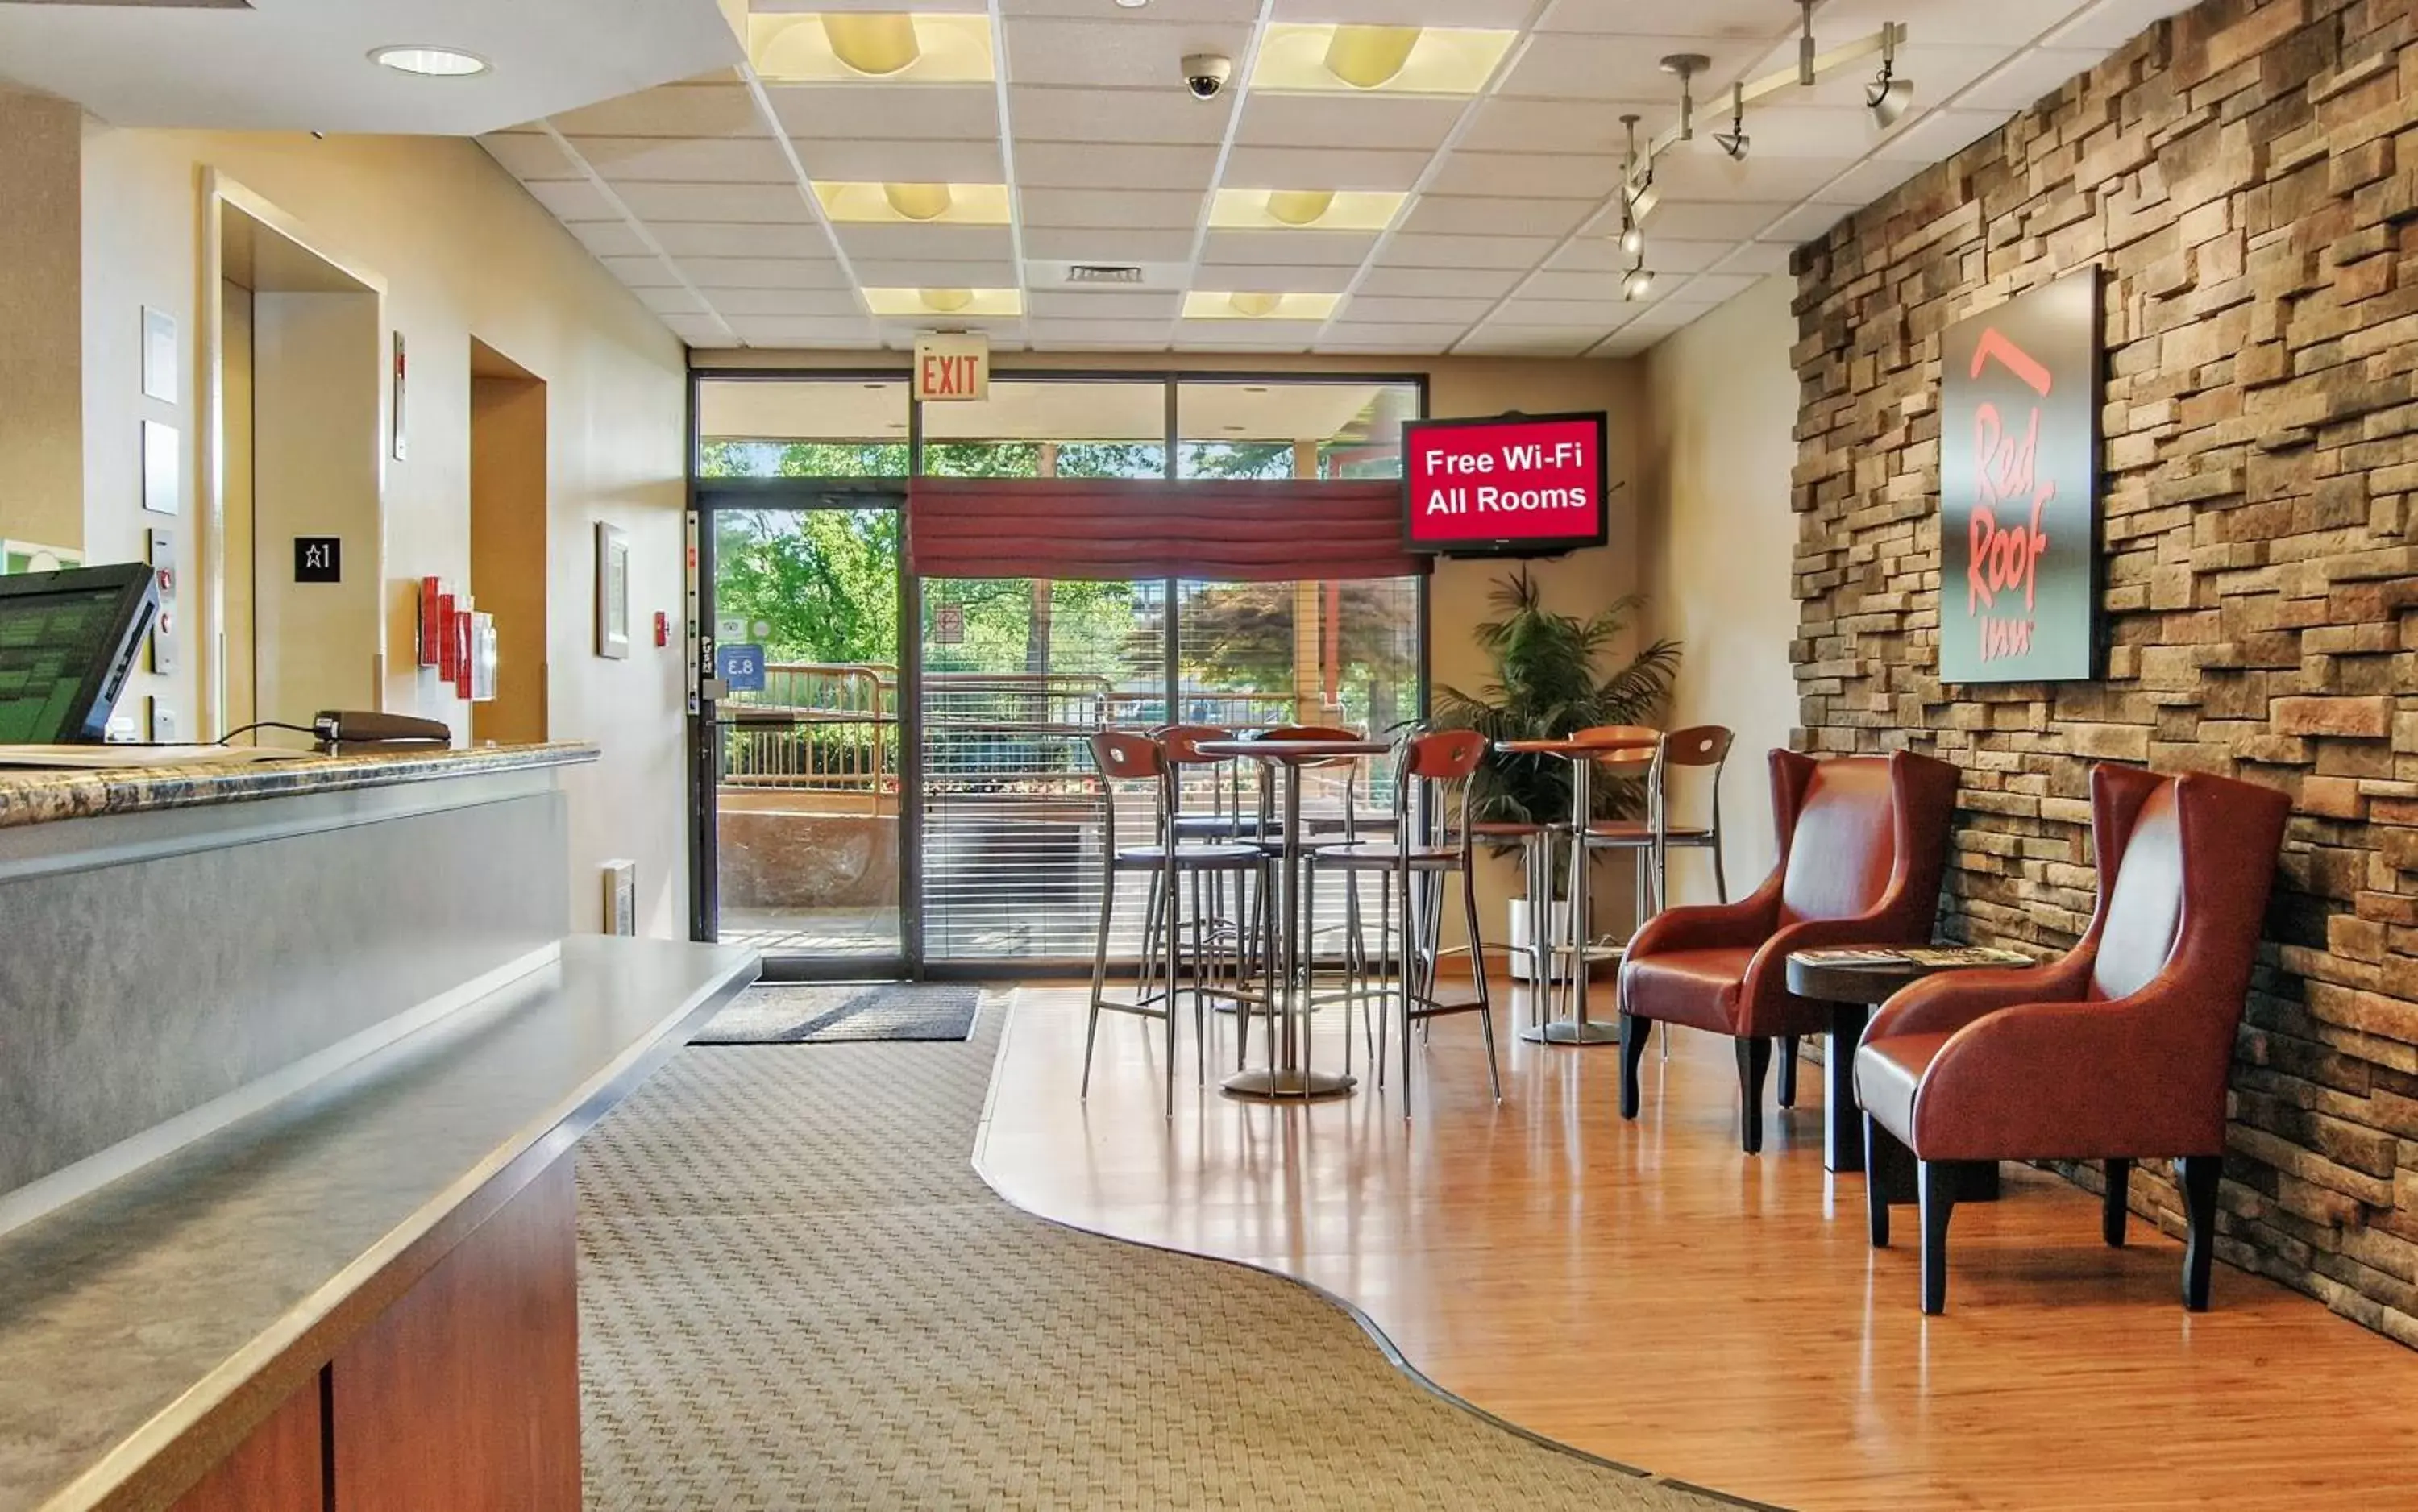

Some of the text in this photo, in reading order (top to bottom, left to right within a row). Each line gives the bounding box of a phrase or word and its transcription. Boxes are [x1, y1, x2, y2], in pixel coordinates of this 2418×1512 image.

[922, 355, 978, 394] EXIT
[1425, 442, 1583, 476] Free Wi-Fi
[1975, 403, 2039, 505] Red
[1426, 486, 1587, 515] All Rooms
[1967, 480, 2055, 617] Roof
[1980, 616, 2035, 663] Inn
